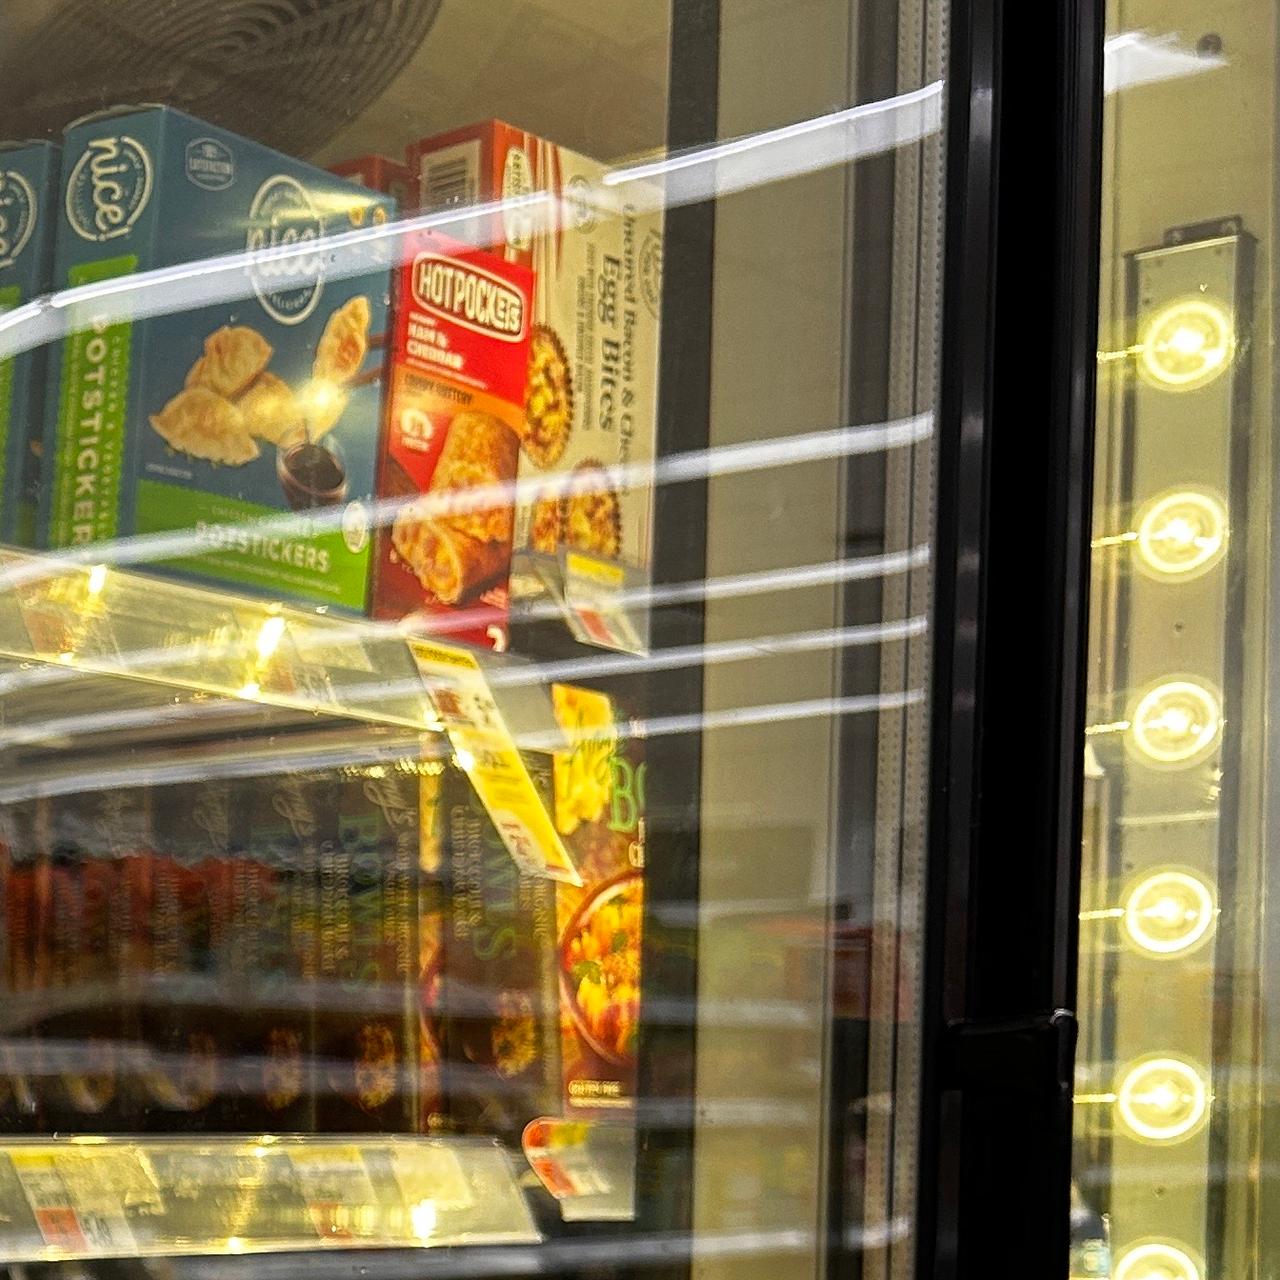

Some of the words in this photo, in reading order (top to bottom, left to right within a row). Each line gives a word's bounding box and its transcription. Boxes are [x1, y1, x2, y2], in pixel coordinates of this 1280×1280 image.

[88, 136, 133, 242] nice!
[596, 252, 621, 326] Egg
[597, 336, 621, 433] Bites
